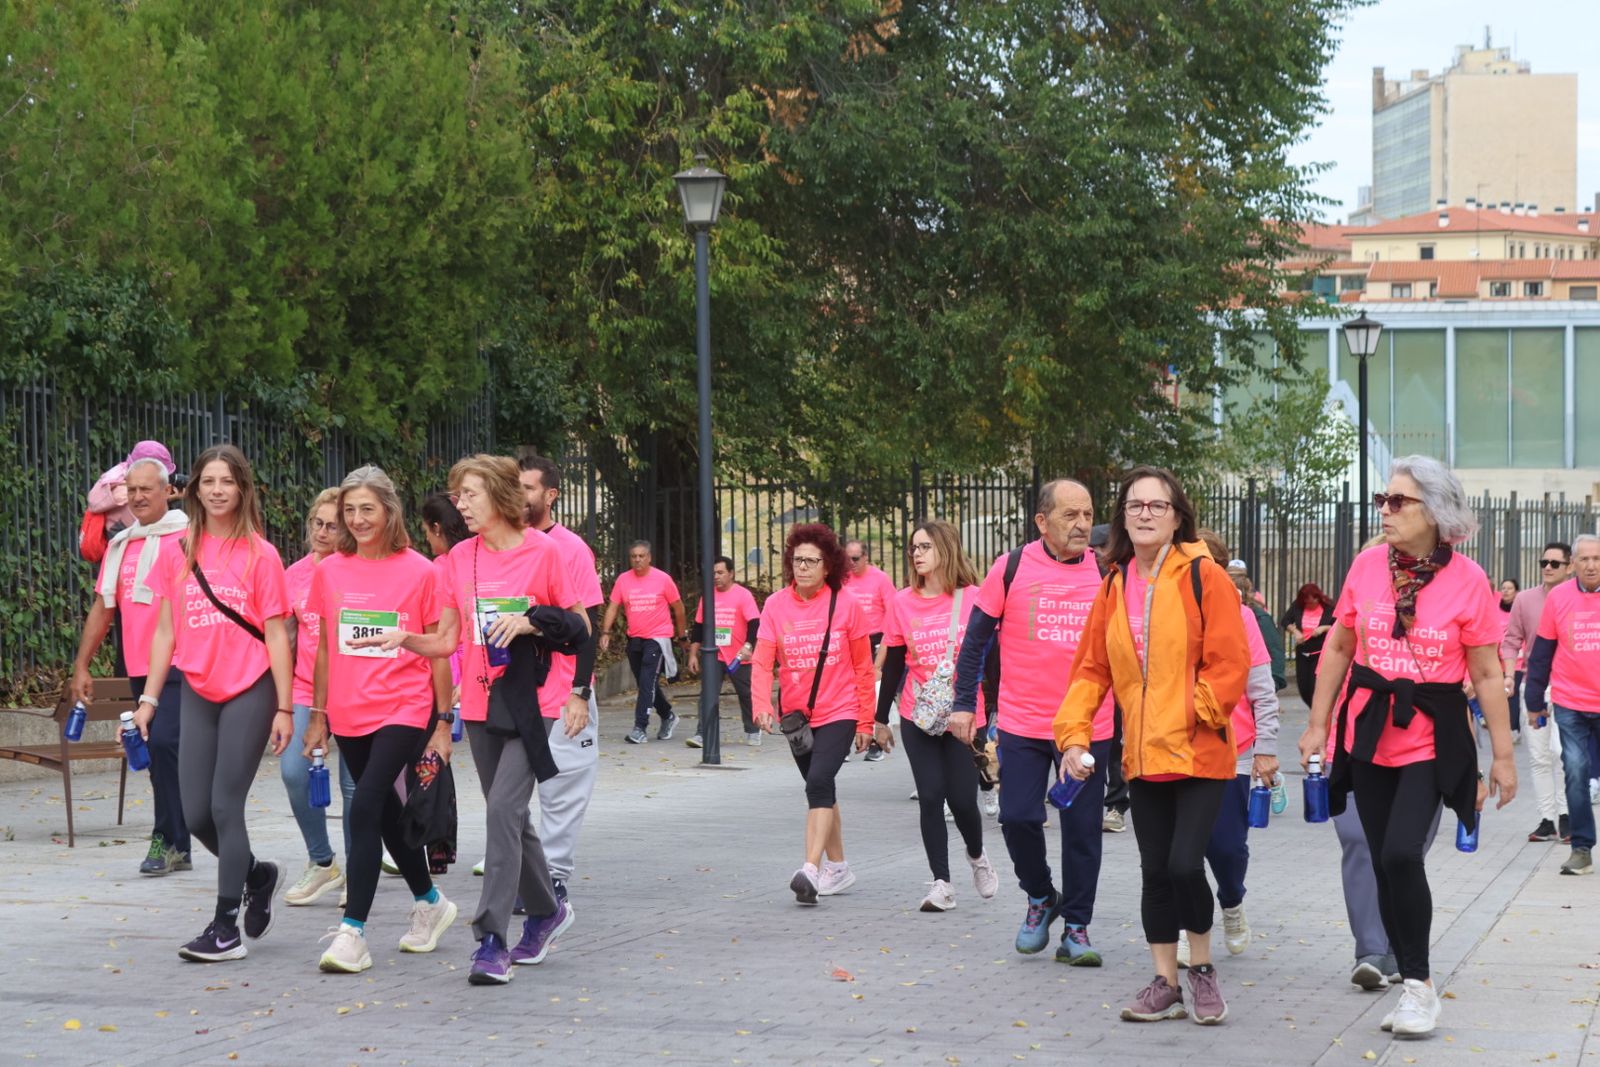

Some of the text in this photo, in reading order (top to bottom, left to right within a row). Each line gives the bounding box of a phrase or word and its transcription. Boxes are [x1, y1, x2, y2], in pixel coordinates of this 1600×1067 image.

[185, 584, 248, 600] En archa
[1039, 597, 1056, 609] En
[1368, 617, 1389, 632] En
[783, 634, 797, 644] En
[912, 630, 927, 641] En
[784, 643, 822, 656] contr
[1367, 636, 1444, 658] contra el
[787, 653, 841, 668] cáner
[1368, 651, 1443, 674] cáncer
